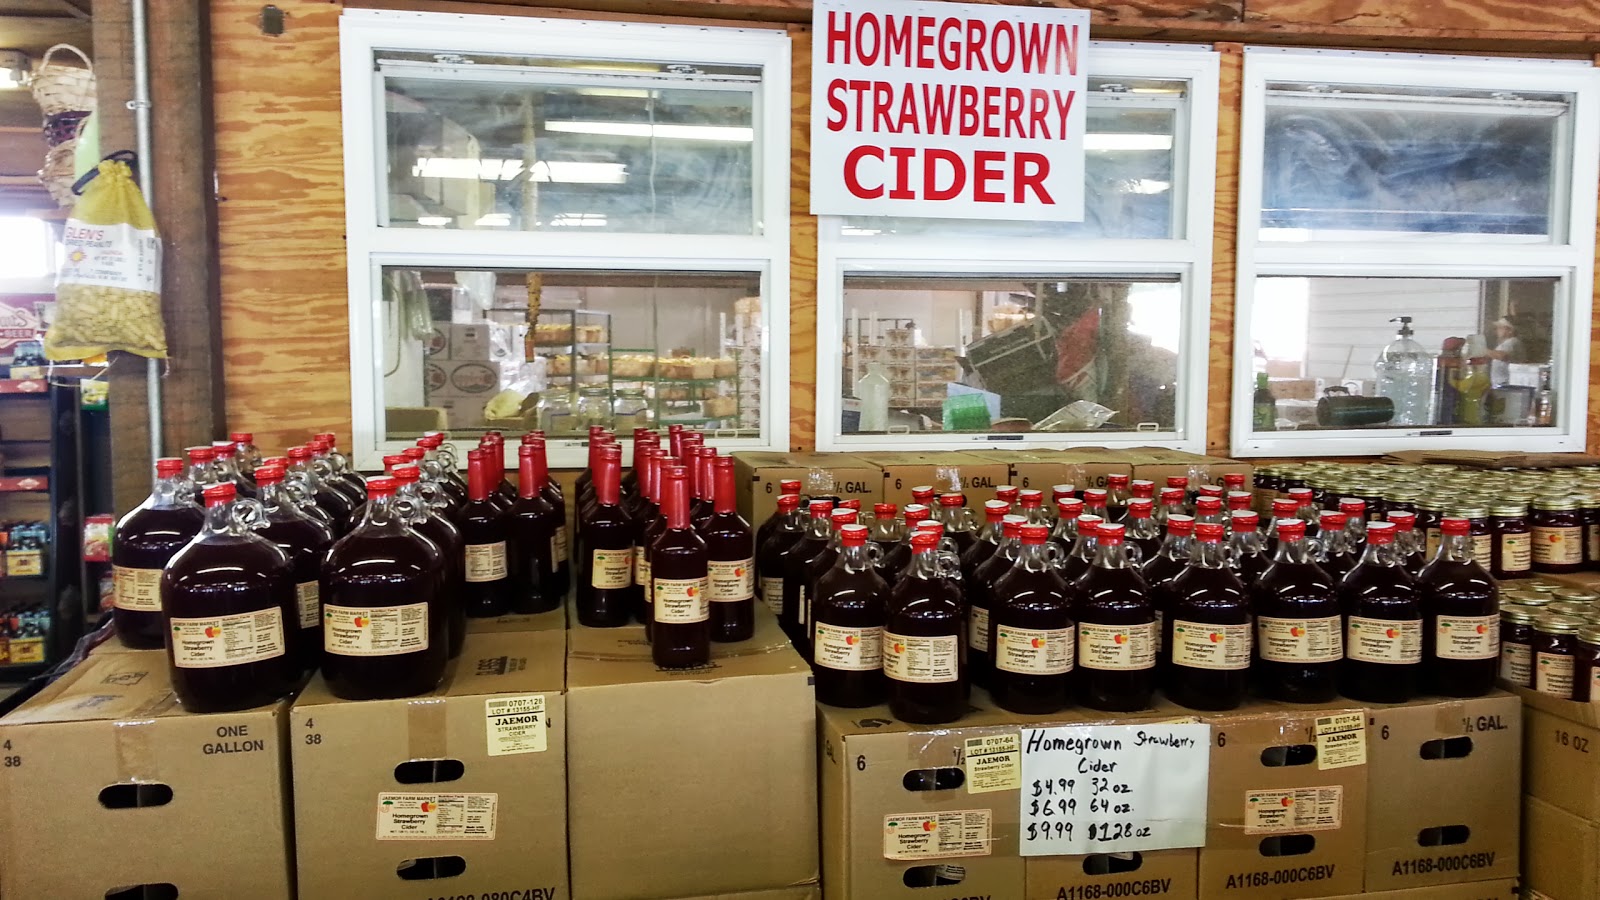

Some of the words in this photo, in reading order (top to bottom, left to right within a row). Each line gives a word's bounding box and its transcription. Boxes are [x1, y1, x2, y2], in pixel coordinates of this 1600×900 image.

[826, 10, 1079, 76] HOMEGROWN
[826, 77, 1076, 141] STRAWBERRY
[843, 144, 1056, 205] CIDER
[766, 482, 772, 494] 6
[845, 482, 872, 494] GAL.
[896, 478, 902, 490] 6
[972, 477, 998, 488] GAL.
[1022, 477, 1029, 488] 6
[1096, 476, 1109, 488] GA
[1185, 646, 1215, 654] Strawberry
[305, 718, 314, 728] 4
[495, 715, 538, 726] JAEMOR
[1382, 725, 1390, 740] 6
[1476, 716, 1508, 732] GAL.
[216, 725, 248, 738] ONE
[305, 734, 322, 745] 38
[1326, 733, 1357, 743] JAEMOR
[3, 740, 12, 750] 4
[202, 740, 264, 755] GALLON
[1026, 729, 1122, 756] Homegrown
[1134, 730, 1196, 748] Strawberry
[1217, 732, 1226, 748] 6
[1555, 730, 1569, 746] 16
[1574, 736, 1590, 754] OZ
[4, 756, 22, 768] 38
[856, 754, 866, 771] 6
[976, 755, 1011, 765] JAEMOR
[1078, 758, 1118, 774] Cider
[1031, 778, 1076, 797] $4.99
[1091, 778, 1109, 796] 32
[1028, 798, 1076, 816] $6.99
[1090, 798, 1110, 814] 64
[1026, 820, 1074, 842] $9.99
[1136, 827, 1152, 838] oz
[1392, 852, 1496, 876] A1168-000C6BV
[1226, 864, 1336, 890] A1168-000C6BV
[1056, 878, 1172, 900] A1168-000C6BV
